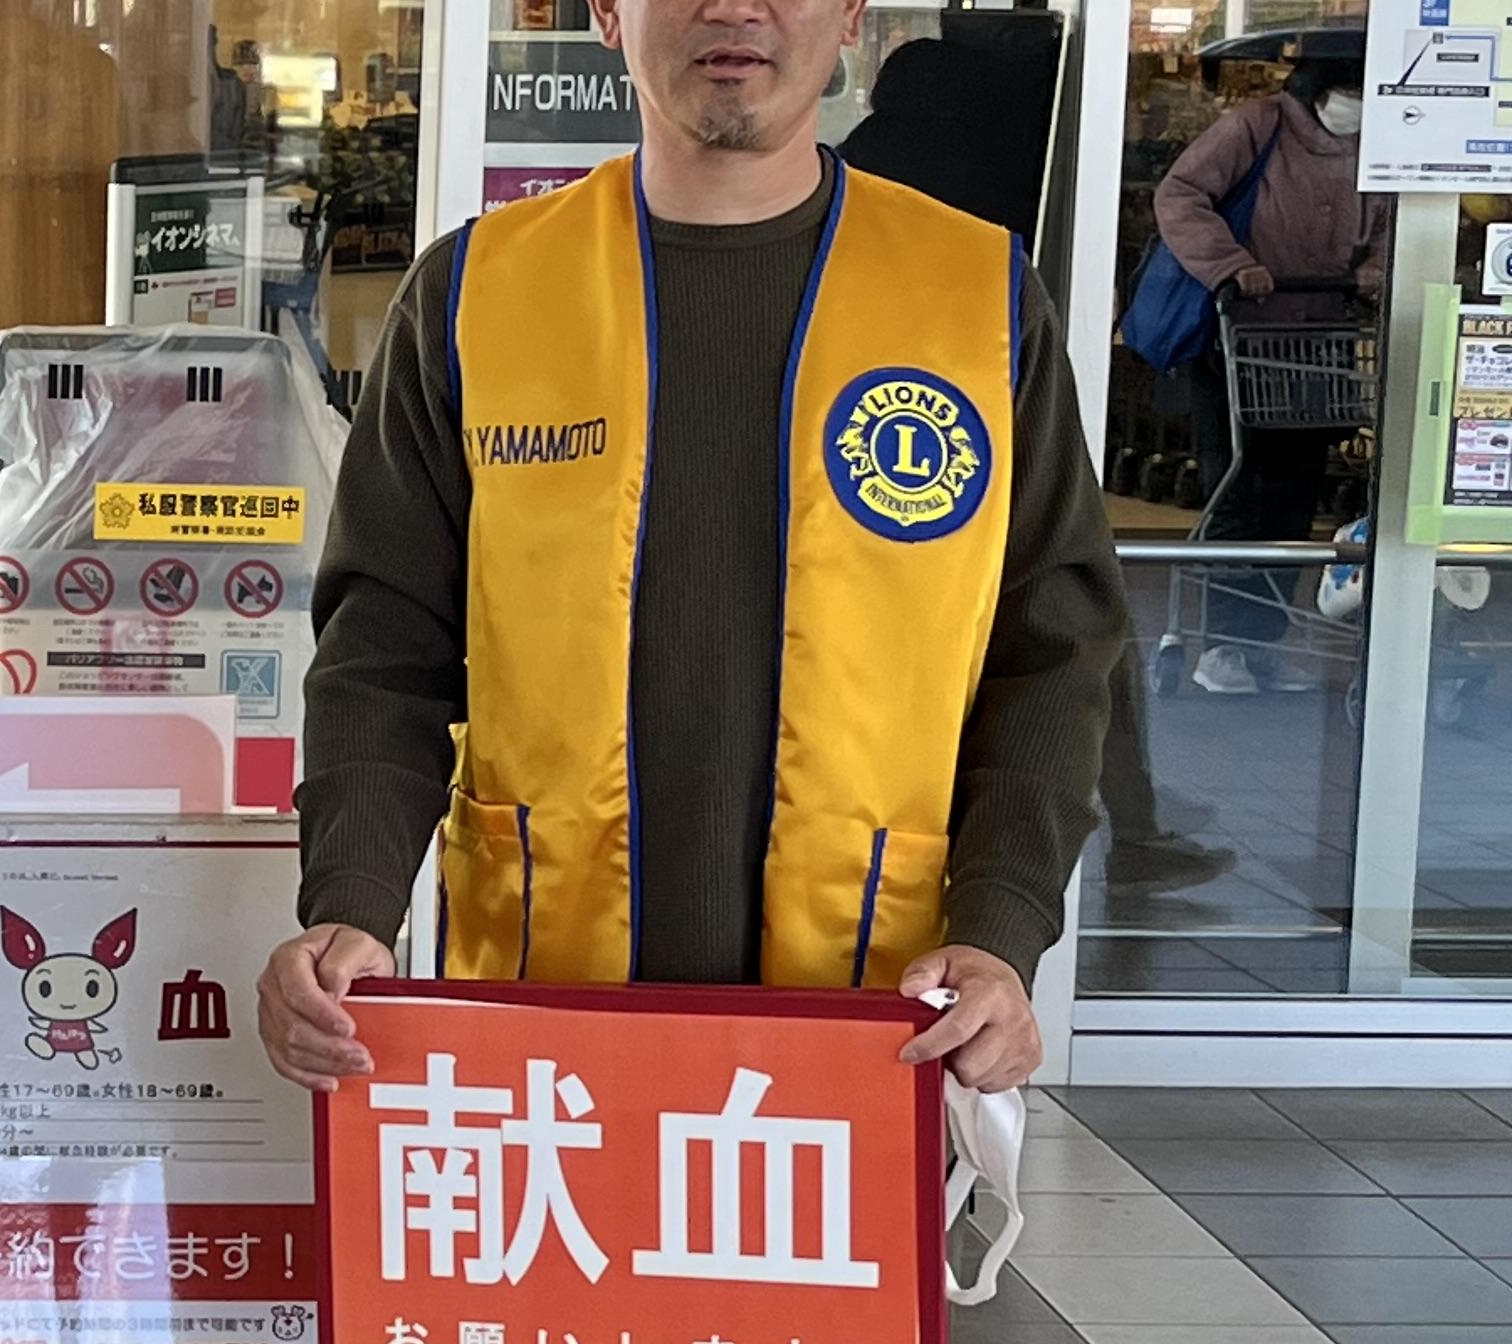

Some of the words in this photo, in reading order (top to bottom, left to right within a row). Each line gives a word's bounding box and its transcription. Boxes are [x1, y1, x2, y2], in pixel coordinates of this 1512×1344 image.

[493, 74, 633, 111] NFORMAT
[869, 385, 952, 420] LIONS
[891, 424, 932, 477] L
[139, 492, 300, 520] 私服警察官巡回中
[368, 1053, 880, 1289] 献血
